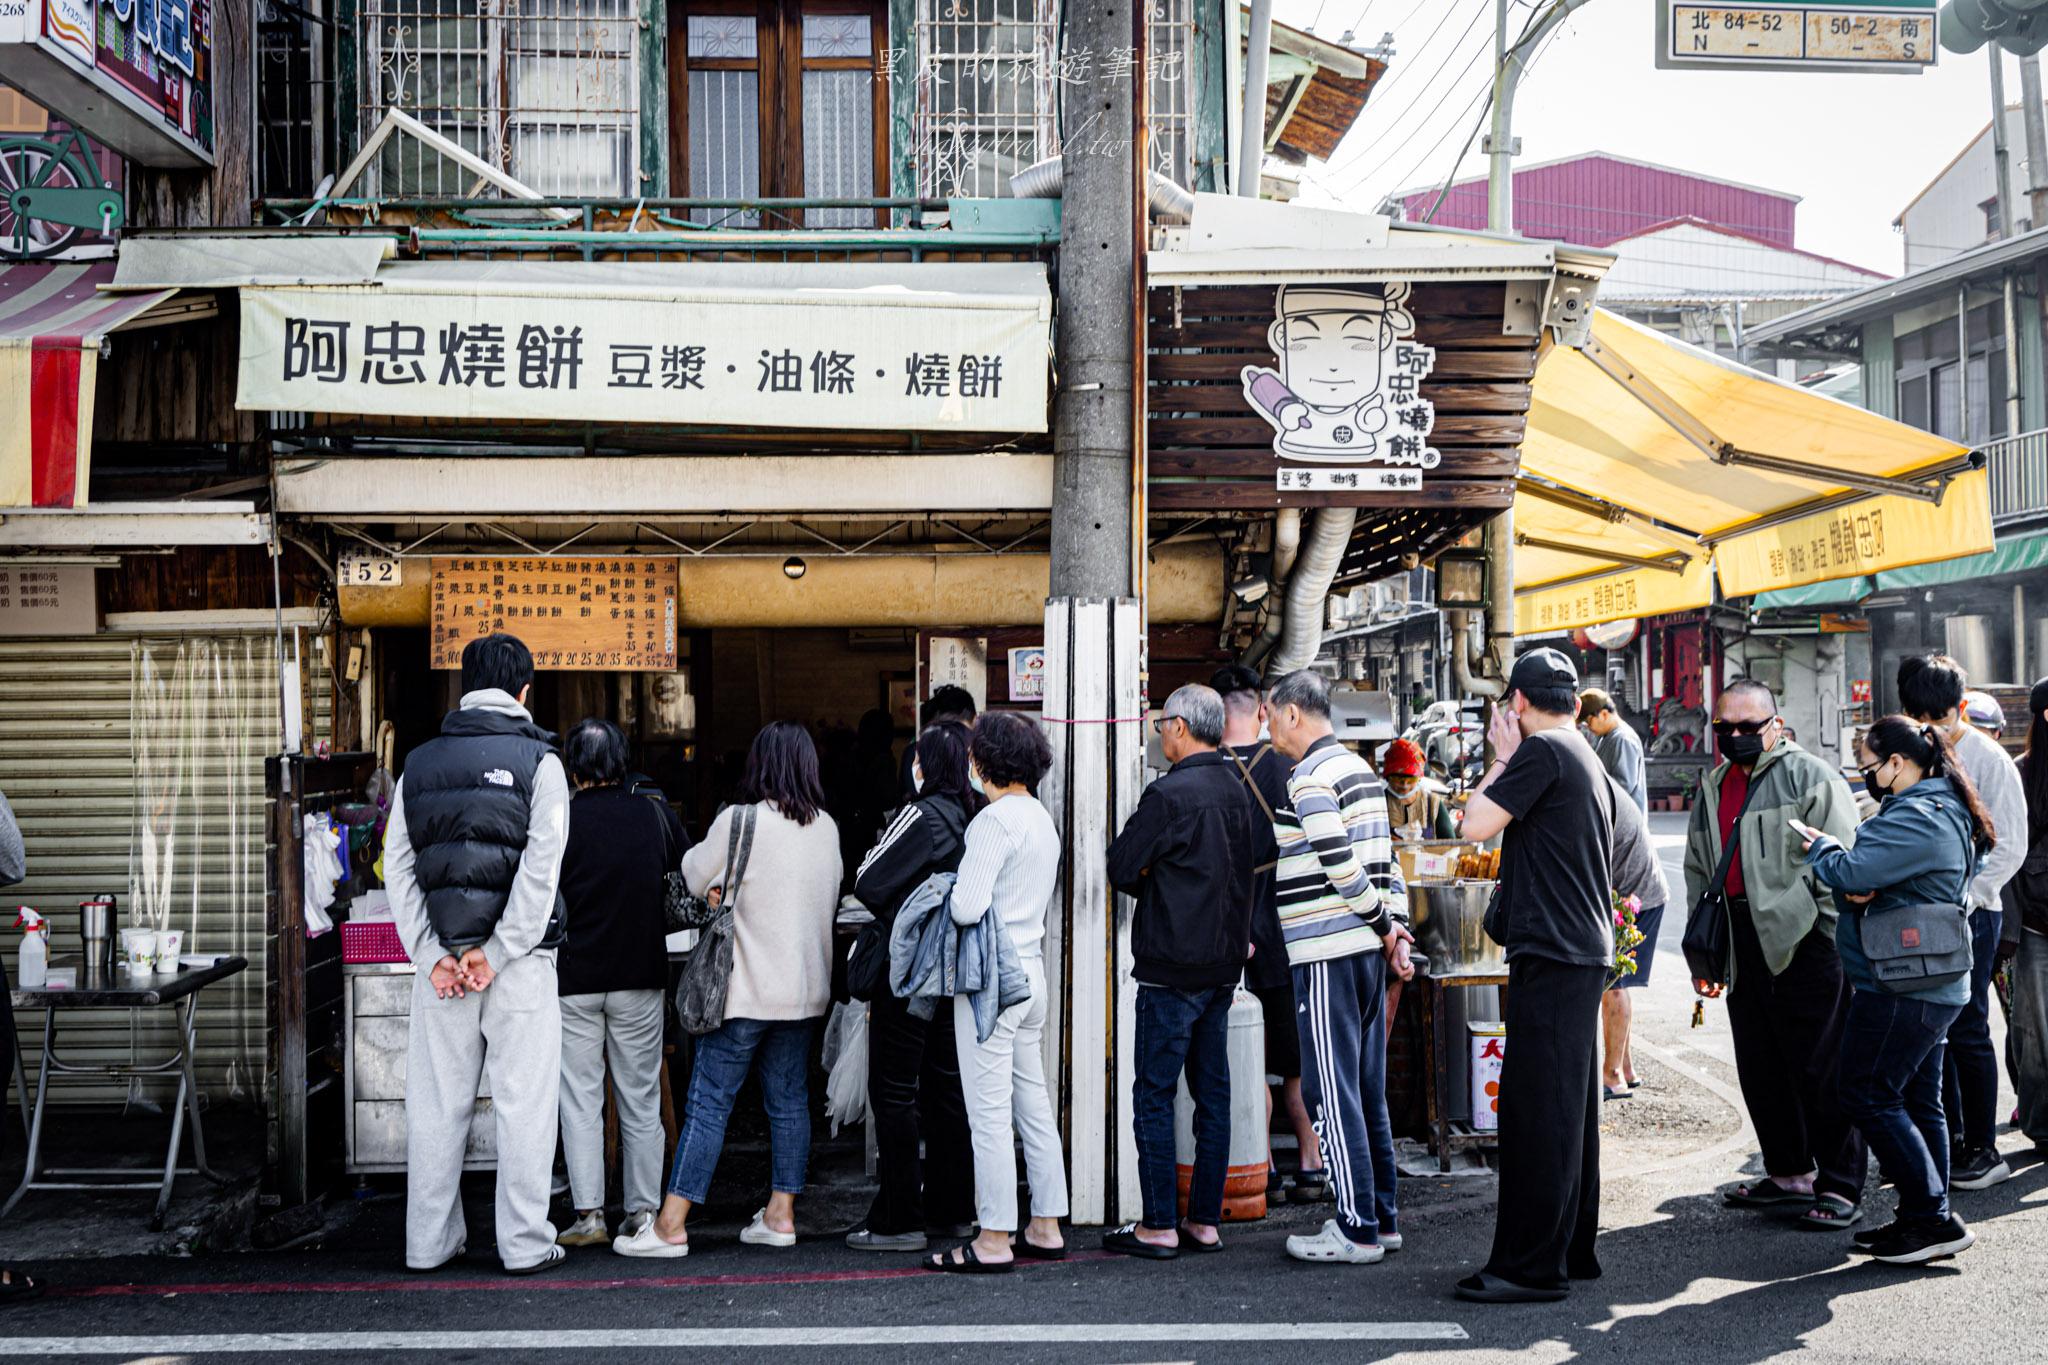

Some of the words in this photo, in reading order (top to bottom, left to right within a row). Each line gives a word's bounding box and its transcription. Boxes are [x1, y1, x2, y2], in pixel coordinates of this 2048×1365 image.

[1691, 11, 1710, 30] 北
[1724, 13, 1782, 31] 84-52
[1830, 17, 1877, 36] 50-2
[1901, 19, 1919, 38] 南
[1694, 35, 1708, 51] N
[1903, 43, 1916, 59] S
[283, 317, 583, 390] 阿忠燒餅
[1387, 346, 1430, 458] 阿忠燒餅
[1281, 472, 1312, 488] 豆漿
[359, 562, 392, 581] 52
[522, 561, 533, 617] 花生餅
[479, 620, 489, 634] 25
[581, 652, 592, 665] 25
[610, 652, 621, 665] 35
